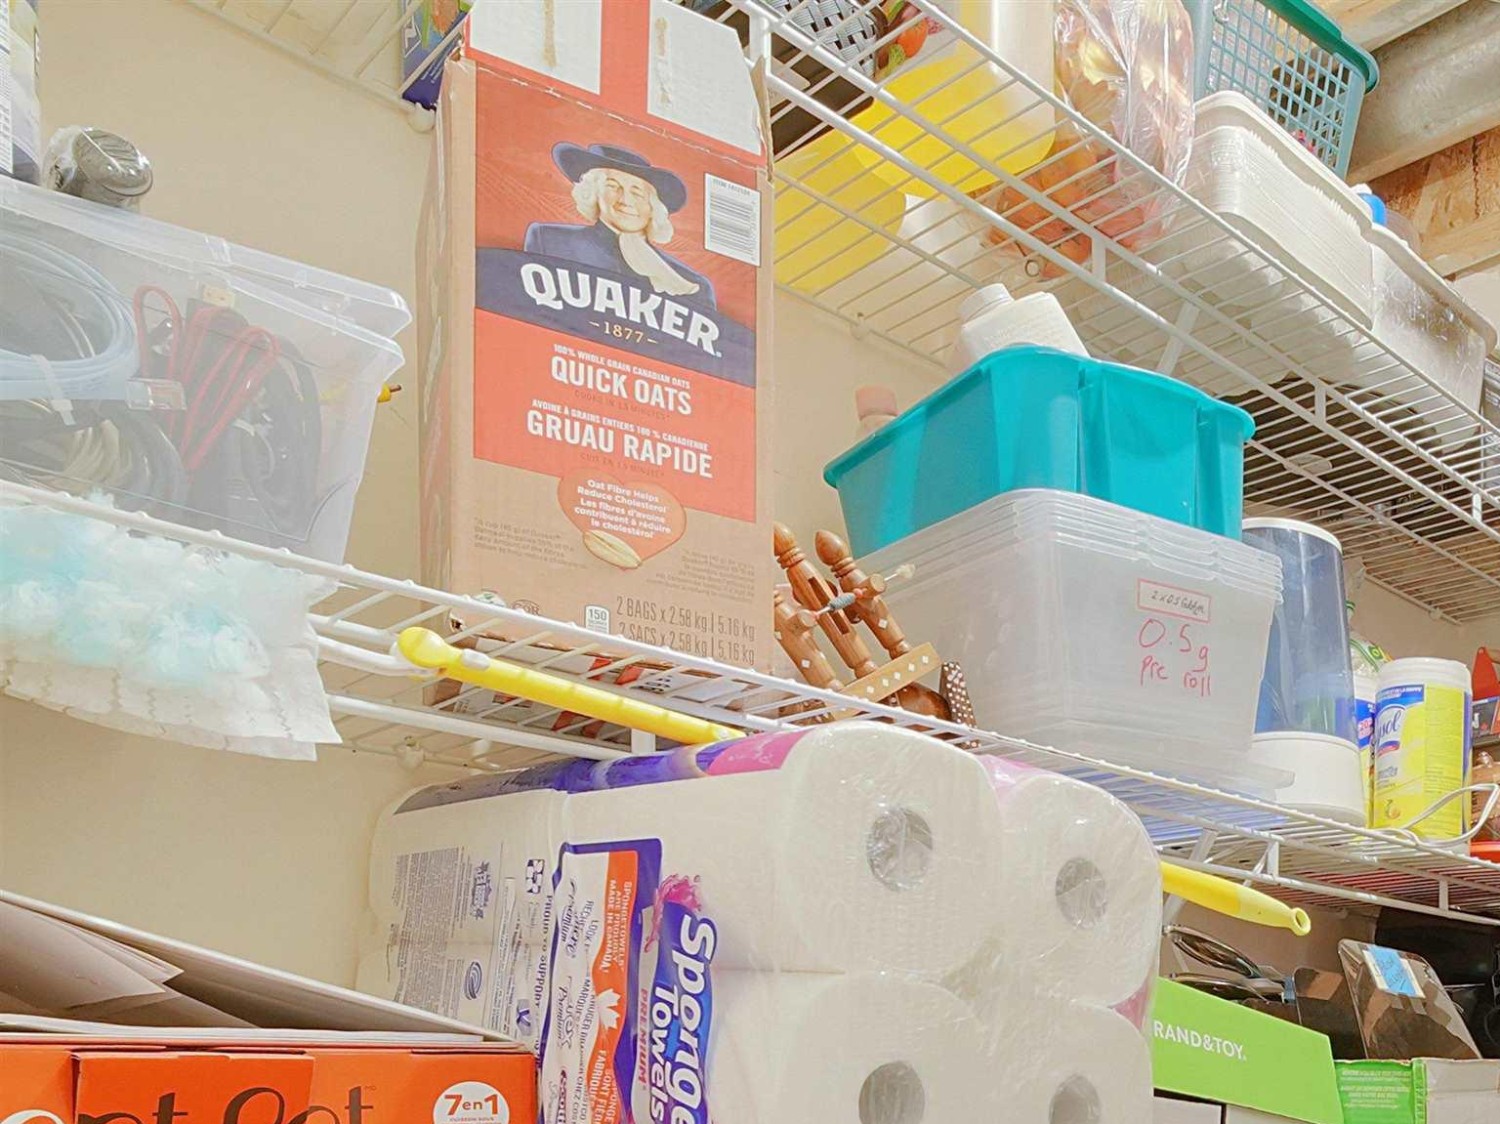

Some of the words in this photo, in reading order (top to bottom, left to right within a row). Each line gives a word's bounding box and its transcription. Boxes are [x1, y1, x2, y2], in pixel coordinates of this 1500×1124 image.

[520, 263, 721, 357] QUAKER
[603, 322, 644, 344] 1877
[551, 356, 628, 399] QUICK
[634, 380, 692, 415] OATS
[578, 349, 604, 365] WHOLE
[606, 355, 631, 372] GRAIN
[632, 363, 669, 384] CANADIAN
[672, 376, 690, 389] OATS
[532, 399, 561, 414] AVOINE
[571, 407, 601, 424] GRAINS
[603, 415, 634, 432] ENTIERS
[663, 433, 709, 452] CANADIENNE
[527, 410, 614, 453] GRUAU
[623, 435, 713, 478] RAPIDE
[577, 486, 613, 502] Reduce
[580, 497, 597, 508] Les
[599, 501, 625, 515] fibres
[587, 479, 605, 491] Oat
[607, 483, 631, 497] Fibre
[634, 489, 659, 503] Helps
[574, 506, 630, 525] contribuent
[639, 517, 671, 534] réduire
[588, 608, 607, 621] 150
[616, 597, 624, 616] 2
[626, 598, 657, 621] BAGS
[668, 603, 692, 626] 2.58
[694, 612, 707, 633] kg
[717, 614, 740, 635] 5.16
[742, 619, 755, 641] kg
[717, 640, 741, 663] 5.16
[742, 645, 755, 665] kg
[1377, 708, 1402, 743] ysol
[607, 879, 616, 910] MADE
[638, 987, 650, 1084] PREMIUM
[650, 985, 678, 1122] Towels
